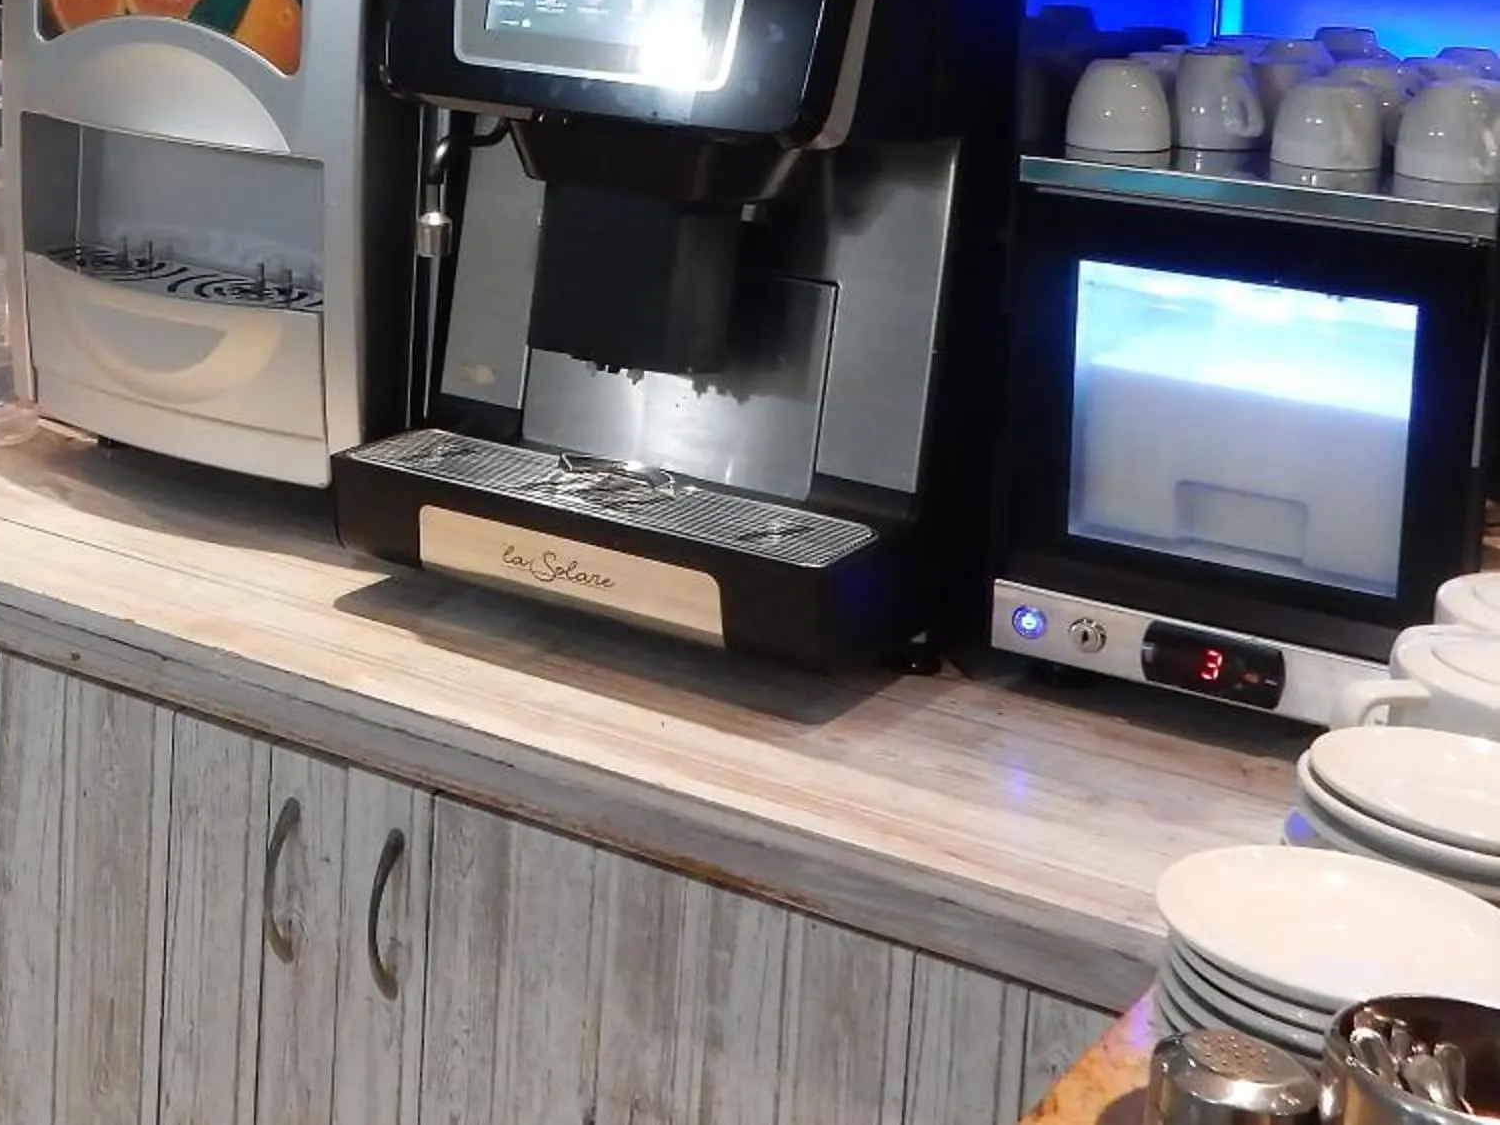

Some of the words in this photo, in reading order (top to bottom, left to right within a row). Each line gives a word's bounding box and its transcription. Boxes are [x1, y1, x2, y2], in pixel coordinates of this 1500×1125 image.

[503, 545, 531, 567] la
[531, 550, 616, 588] Solare
[1201, 649, 1223, 680] 3
